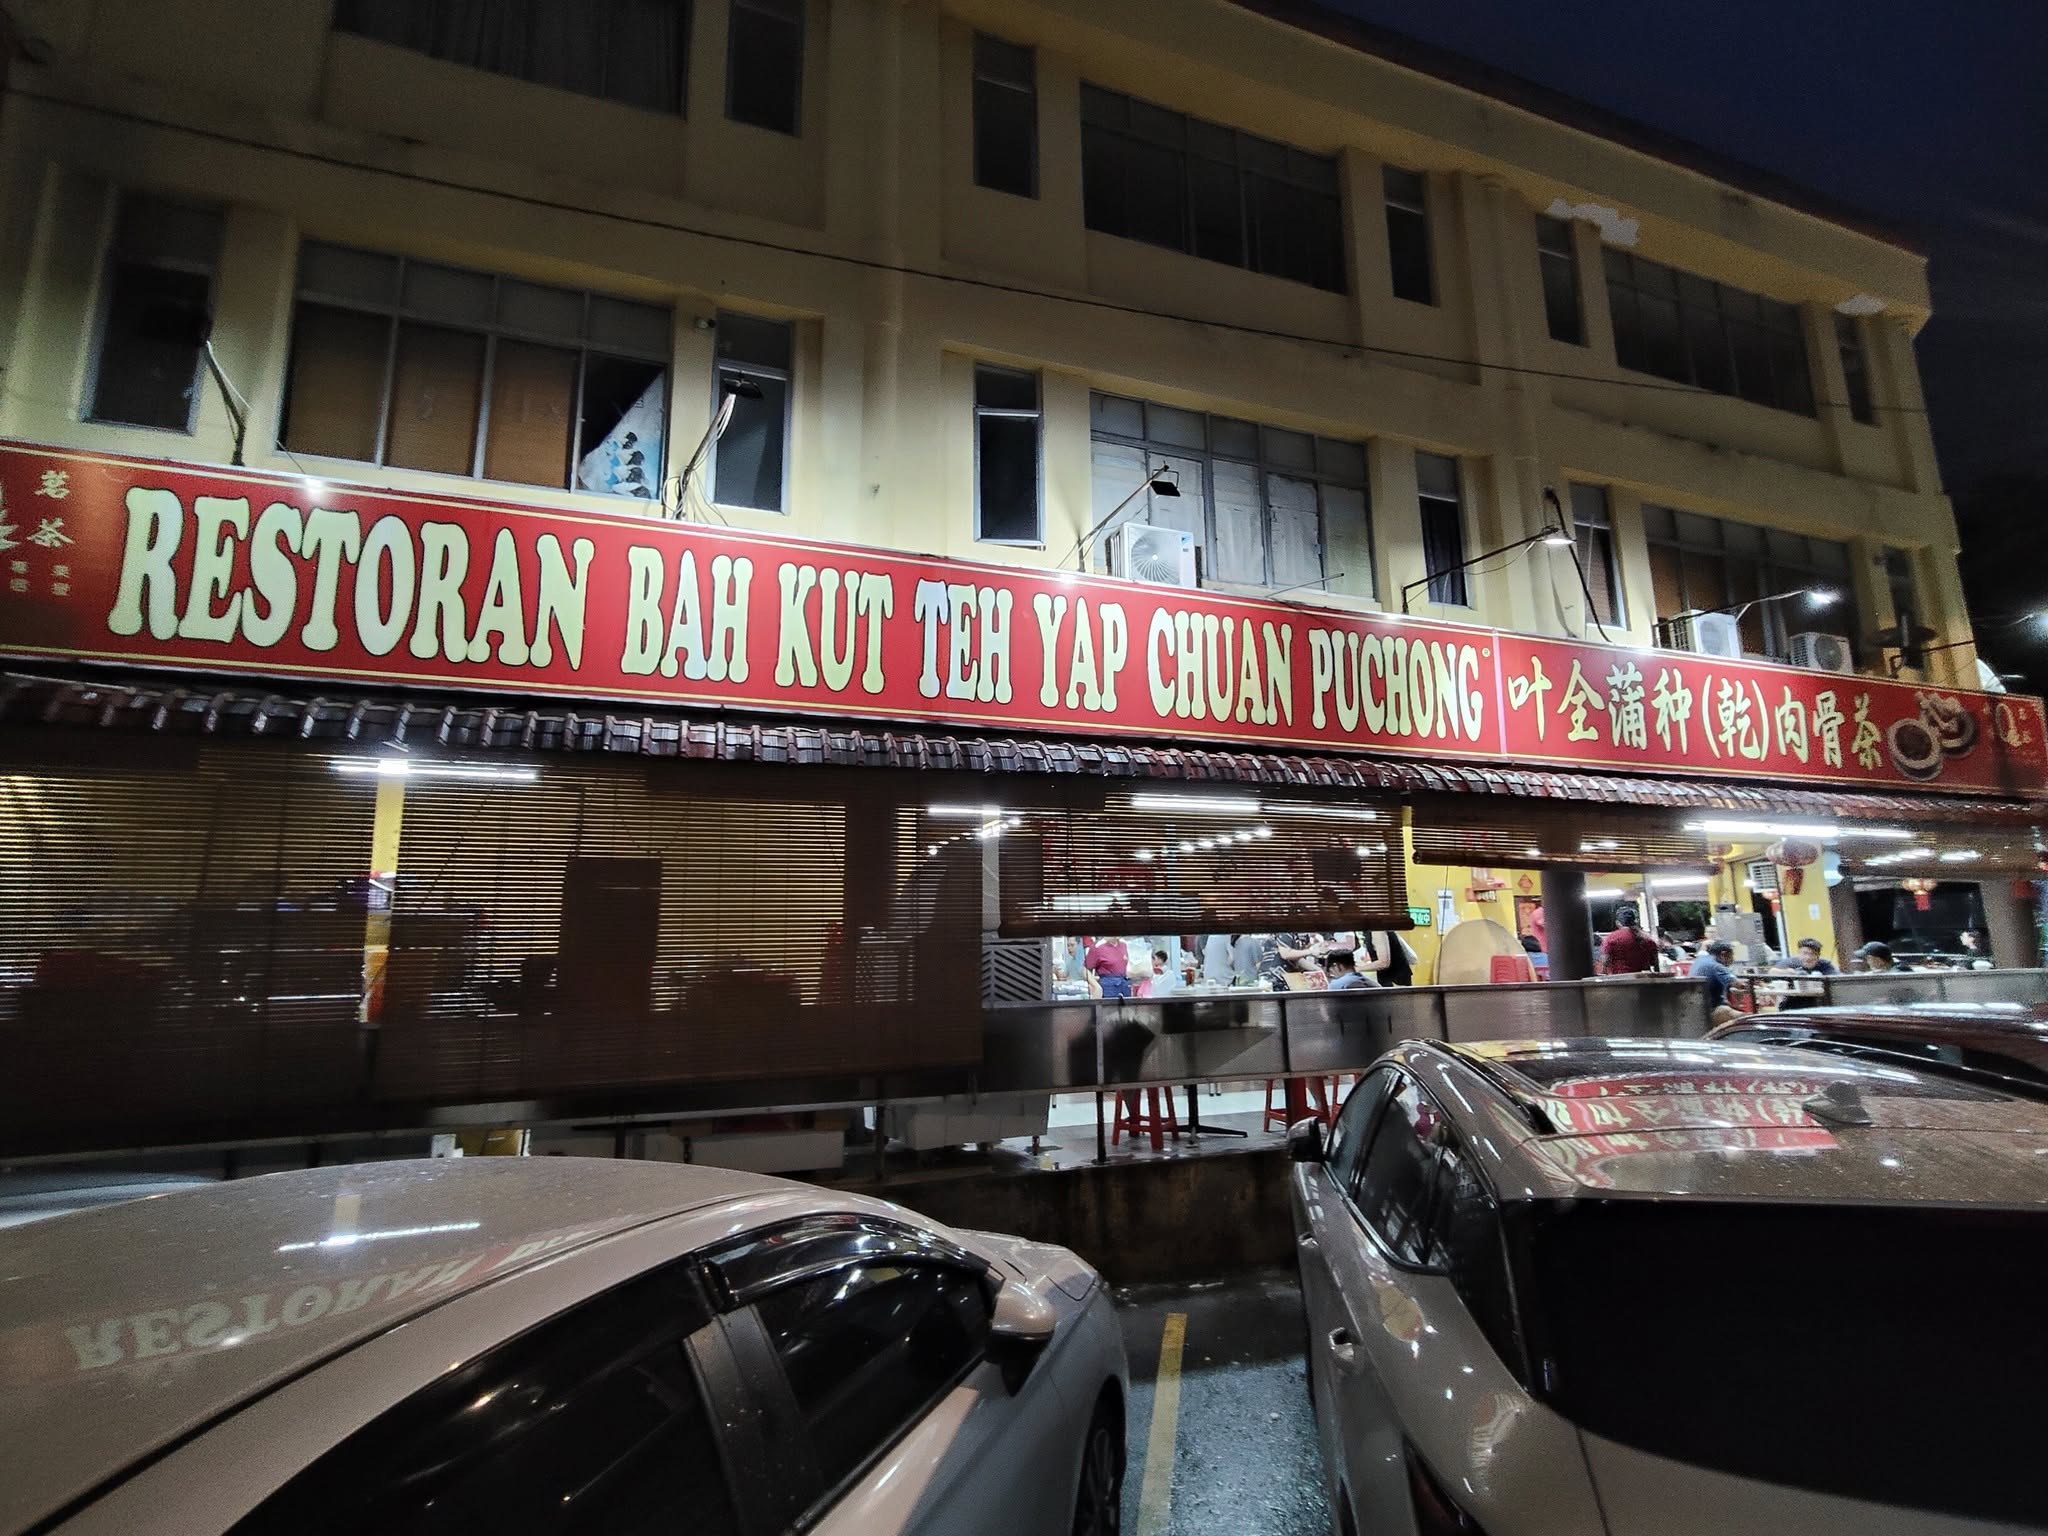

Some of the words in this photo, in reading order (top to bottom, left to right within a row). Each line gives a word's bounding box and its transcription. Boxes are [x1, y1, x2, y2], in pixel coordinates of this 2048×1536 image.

[108, 486, 596, 672] RESTORAN
[620, 545, 754, 684] BAH
[774, 562, 895, 694] KUT
[914, 577, 1013, 704] TEH
[1033, 592, 1128, 713] YAP
[1146, 606, 1293, 727] CHUAN
[1308, 628, 1484, 742] PUCHONG
